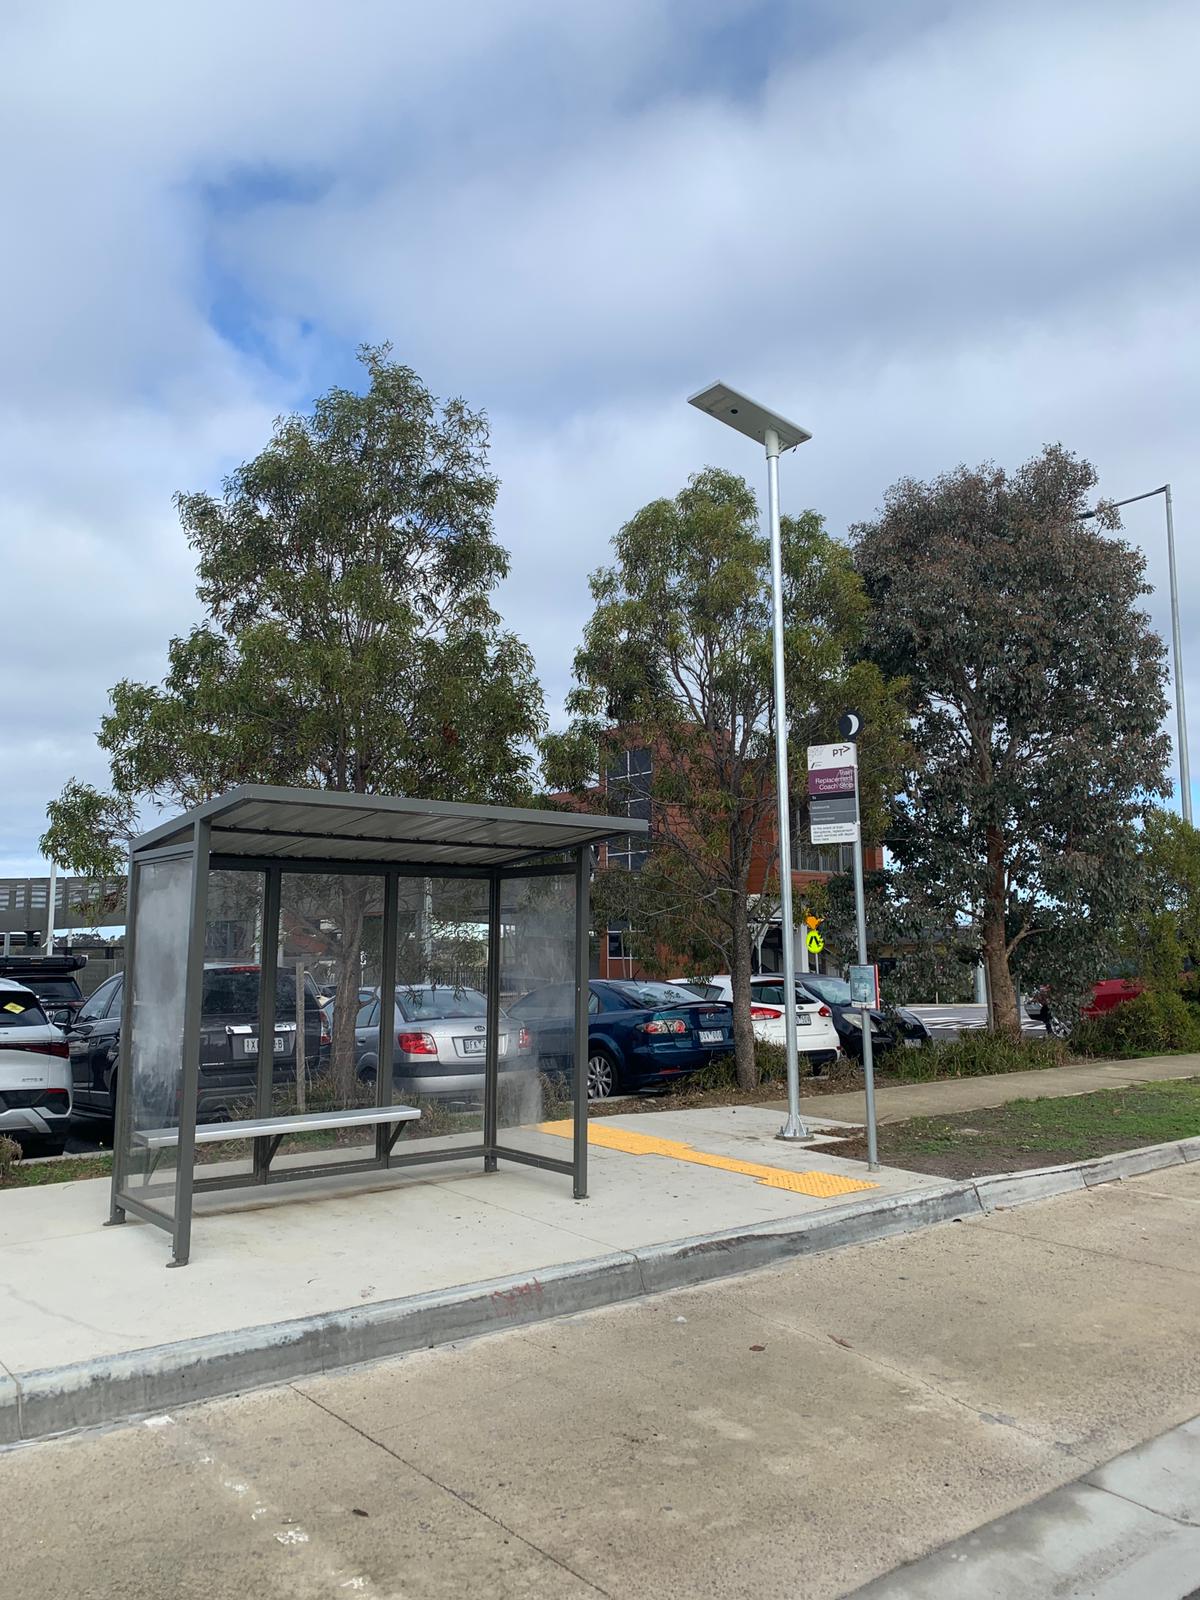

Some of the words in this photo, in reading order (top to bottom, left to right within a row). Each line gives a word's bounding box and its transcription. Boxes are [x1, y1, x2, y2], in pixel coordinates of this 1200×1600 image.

[815, 776, 853, 785] Replacement
[818, 783, 838, 791] Coach
[839, 781, 854, 790] Stop
